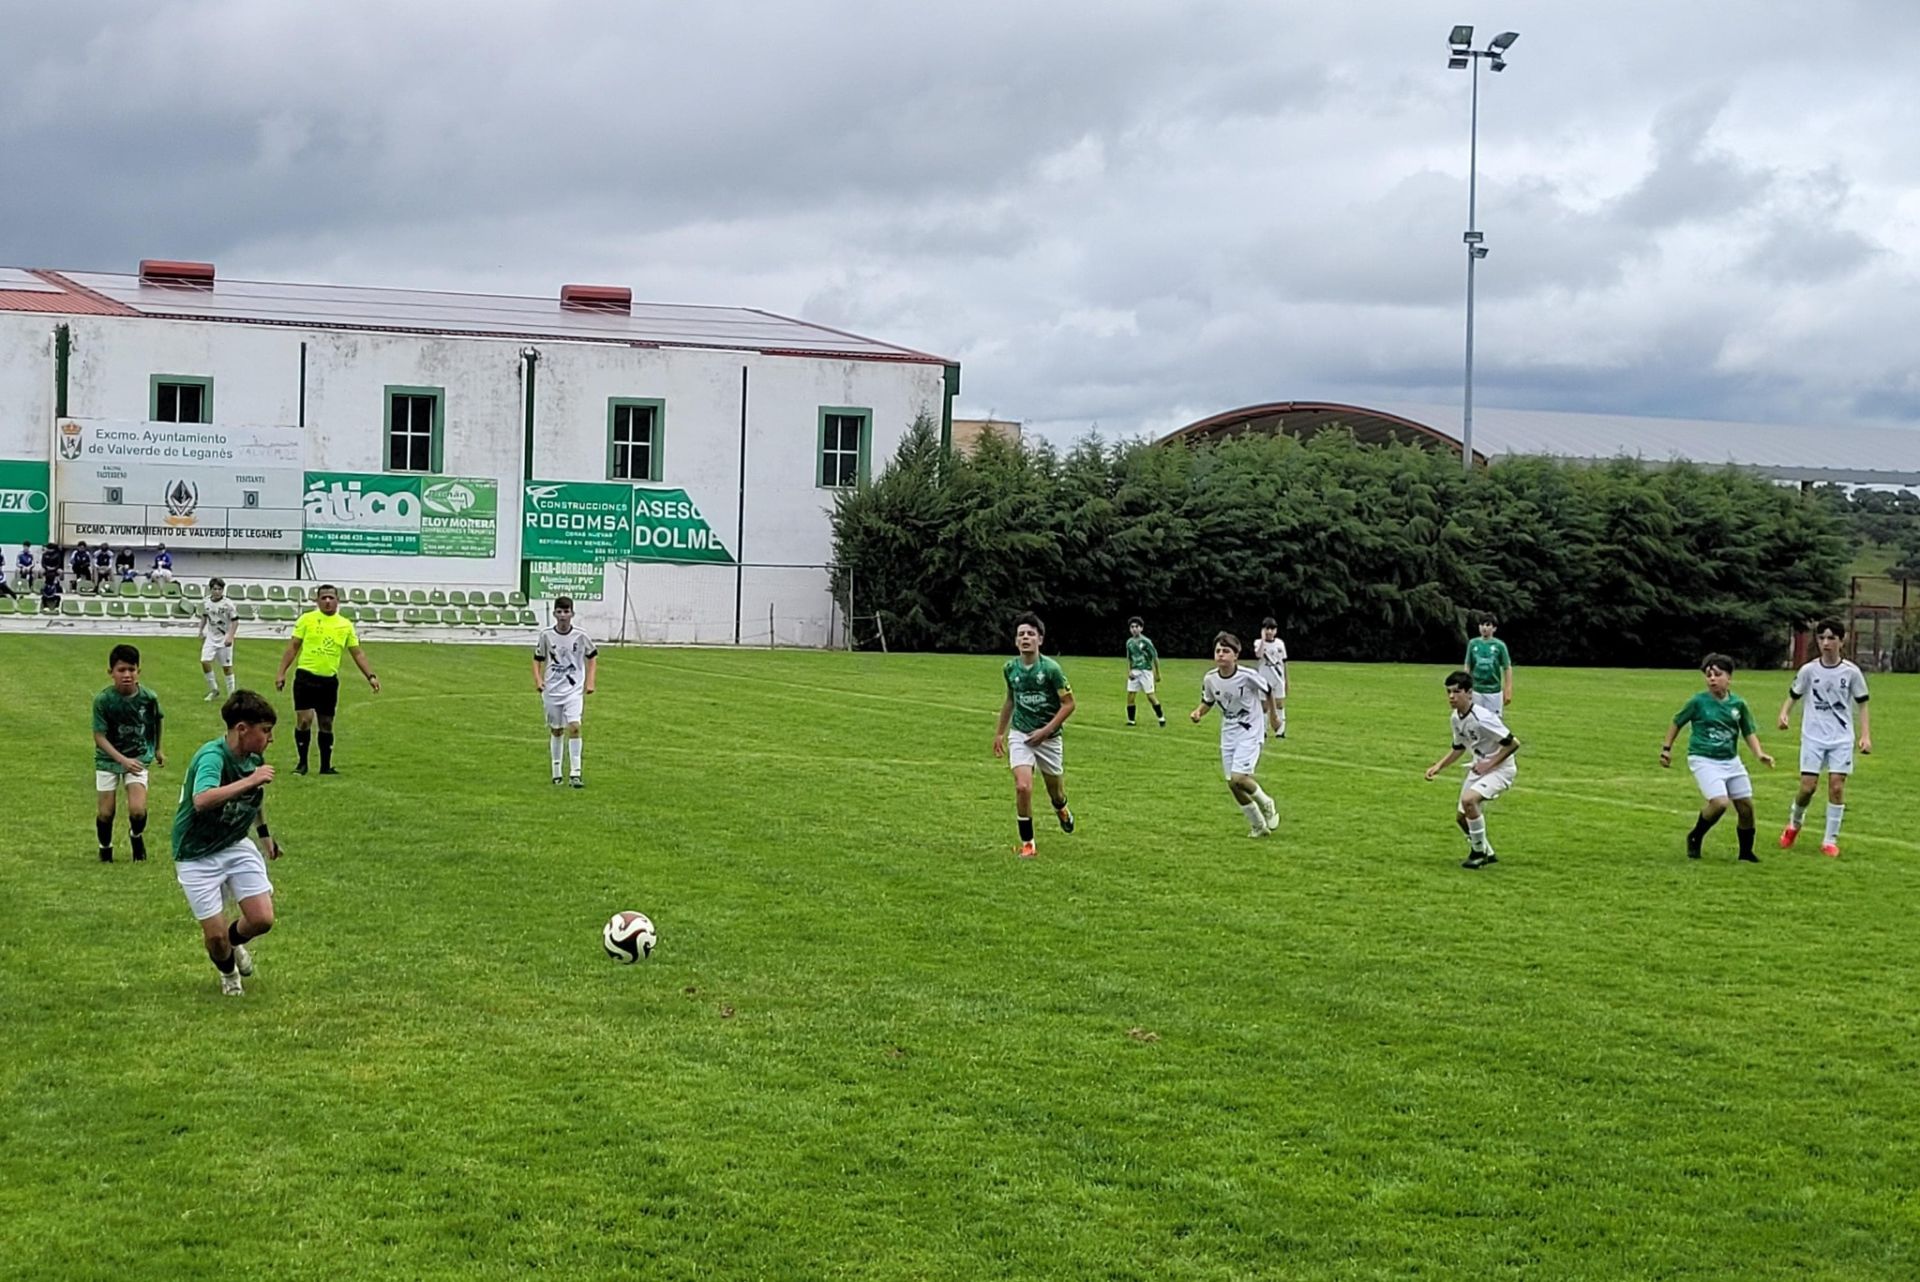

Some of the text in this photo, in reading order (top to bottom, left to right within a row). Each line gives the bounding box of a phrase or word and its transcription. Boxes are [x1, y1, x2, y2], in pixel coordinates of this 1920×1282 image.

[95, 428, 227, 444] Excmo. Ayuntamiento
[88, 443, 104, 454] de
[107, 444, 160, 456] Valverde
[163, 446, 179, 457] de
[540, 500, 628, 511] CONSTRUCCIONES
[422, 516, 496, 529] ELOY MORERA
[526, 512, 630, 532] ROGOMSA
[75, 524, 108, 534] EXCMO.
[109, 525, 174, 537] AYUNTAMIENTO
[175, 527, 188, 537] DE
[189, 528, 232, 538] VALVERDE
[232, 528, 245, 538] DE
